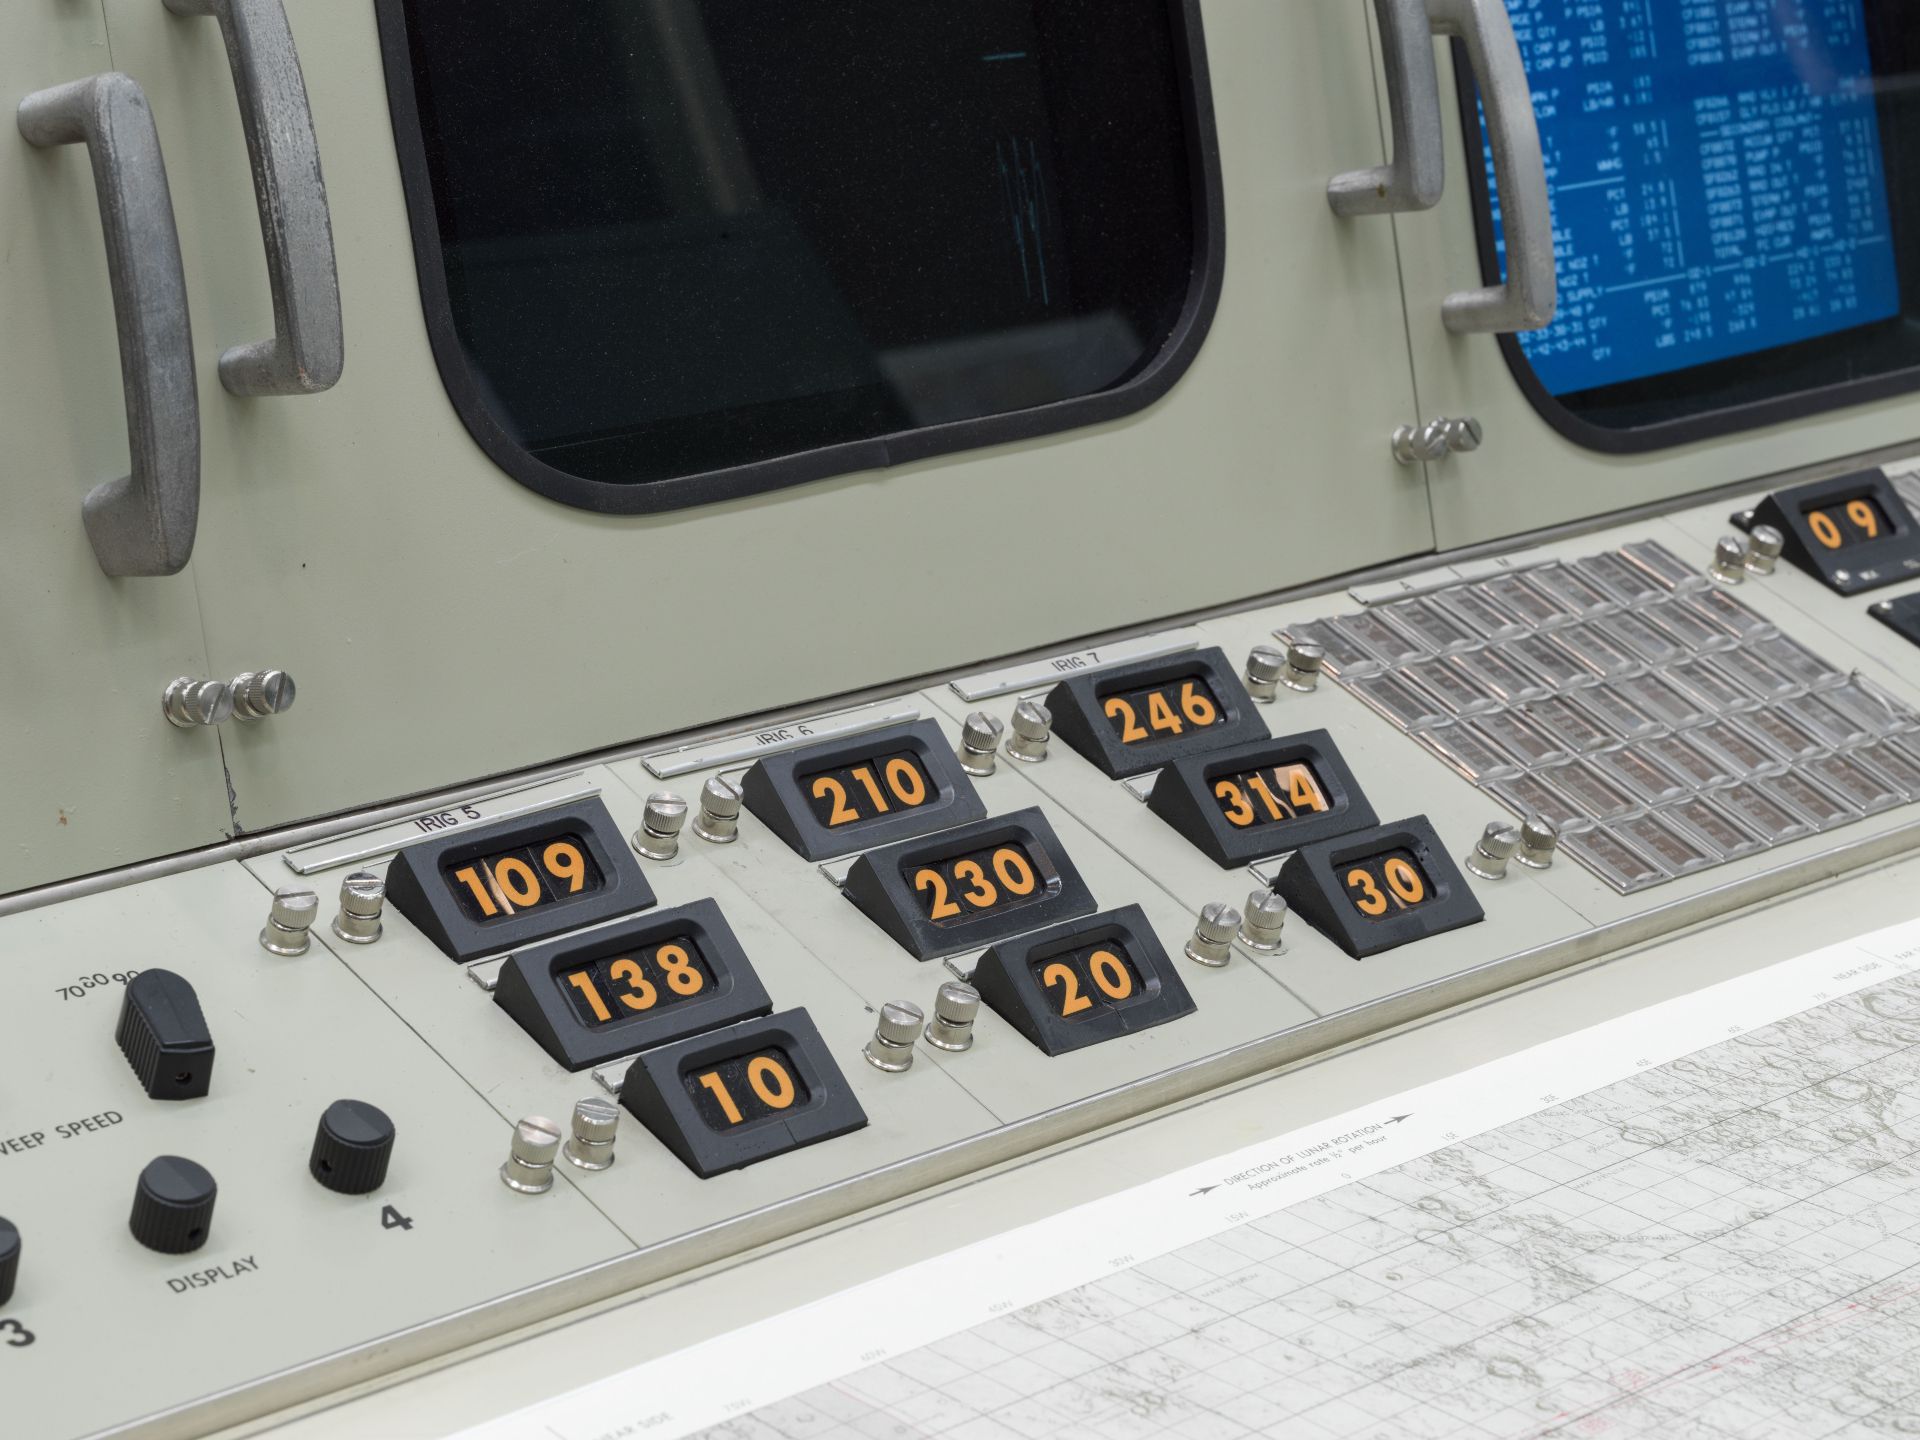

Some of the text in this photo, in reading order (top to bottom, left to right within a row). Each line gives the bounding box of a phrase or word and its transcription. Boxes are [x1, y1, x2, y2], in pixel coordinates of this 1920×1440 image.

[1808, 500, 1878, 549] 09
[1051, 652, 1100, 672] IRIG 7
[1105, 681, 1216, 743] 246
[414, 804, 481, 832] IRIG 5
[812, 758, 927, 826] 210
[1215, 768, 1323, 827] 314
[455, 842, 586, 917] 109
[915, 848, 1036, 920] 230
[1347, 857, 1425, 916] 30
[55, 985, 86, 1001] 70
[568, 944, 704, 1022] 138
[1043, 950, 1133, 1016] 20
[699, 1056, 796, 1125] 10
[55, 1110, 124, 1139] SPEED
[1223, 1123, 1384, 1187] DIRECTION OF LUNAR ROTATION
[1247, 1164, 1308, 1192] Approximate
[1309, 1156, 1331, 1168] rate
[1348, 1144, 1366, 1155] per
[1366, 1135, 1389, 1147] hour
[381, 1204, 413, 1231] 4
[167, 1255, 259, 1293] DISPLAY
[0, 1318, 36, 1348] 3
